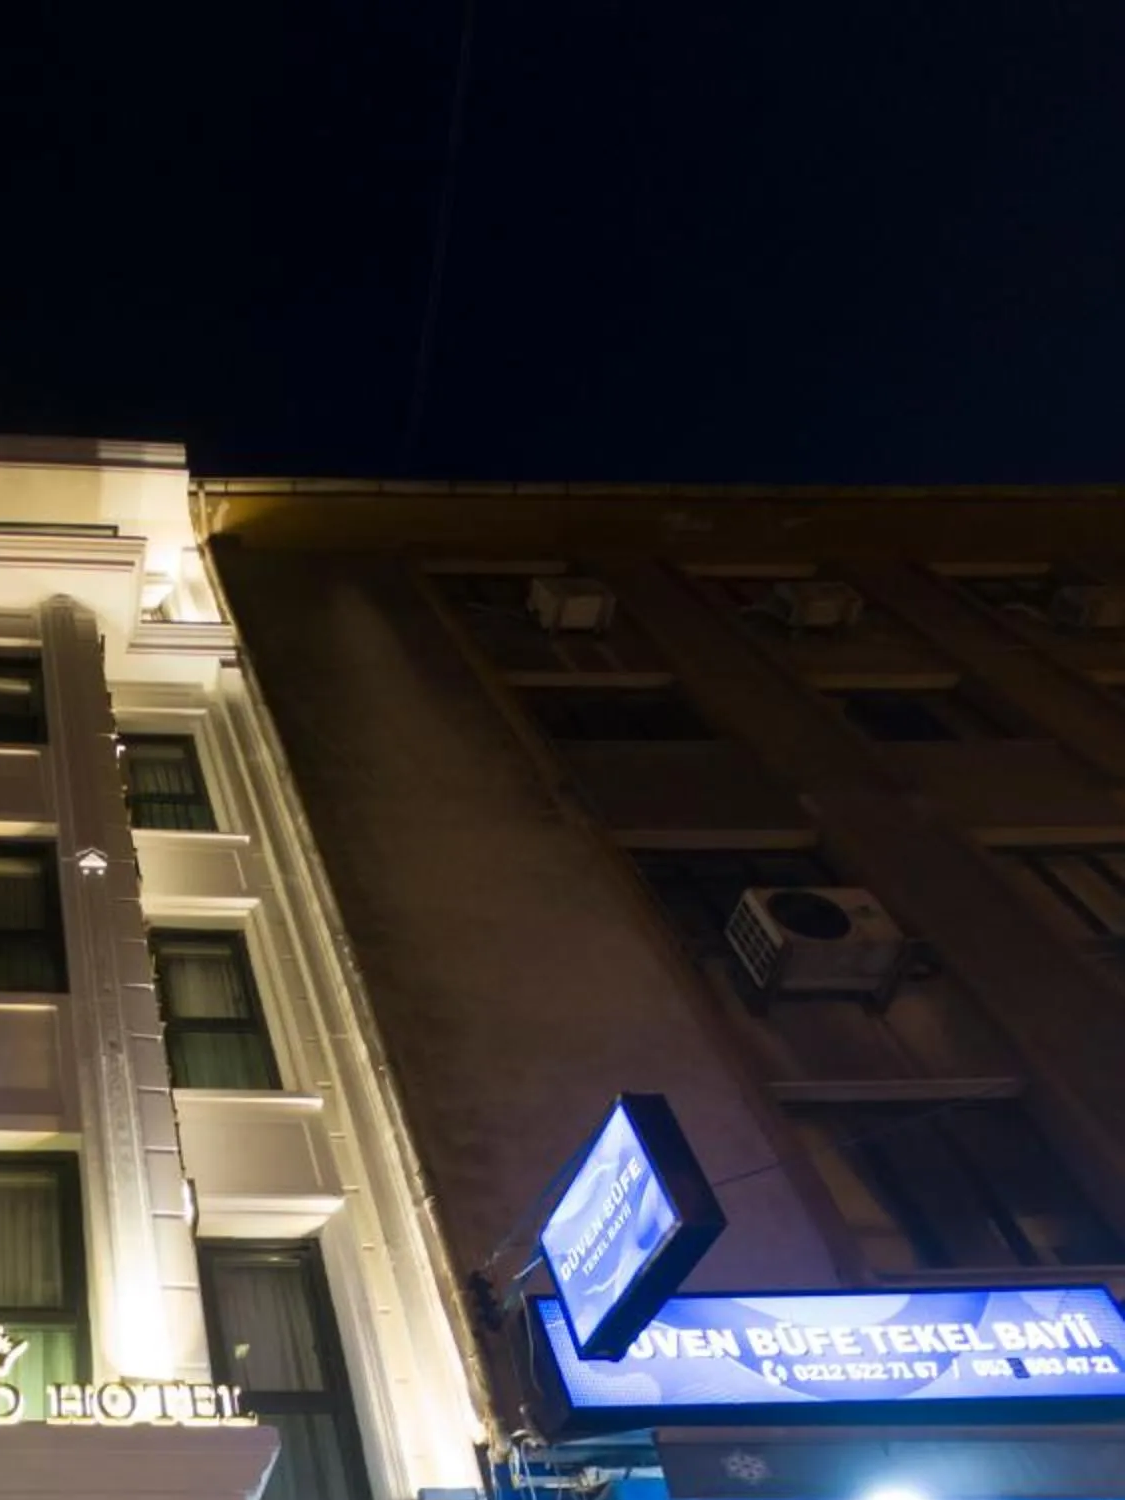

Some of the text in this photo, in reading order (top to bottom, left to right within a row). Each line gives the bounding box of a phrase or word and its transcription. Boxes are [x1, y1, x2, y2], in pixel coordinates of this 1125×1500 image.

[745, 1321, 862, 1357] BÜFE
[859, 1323, 994, 1353] TEKEL
[46, 1381, 258, 1426] HOTEL
